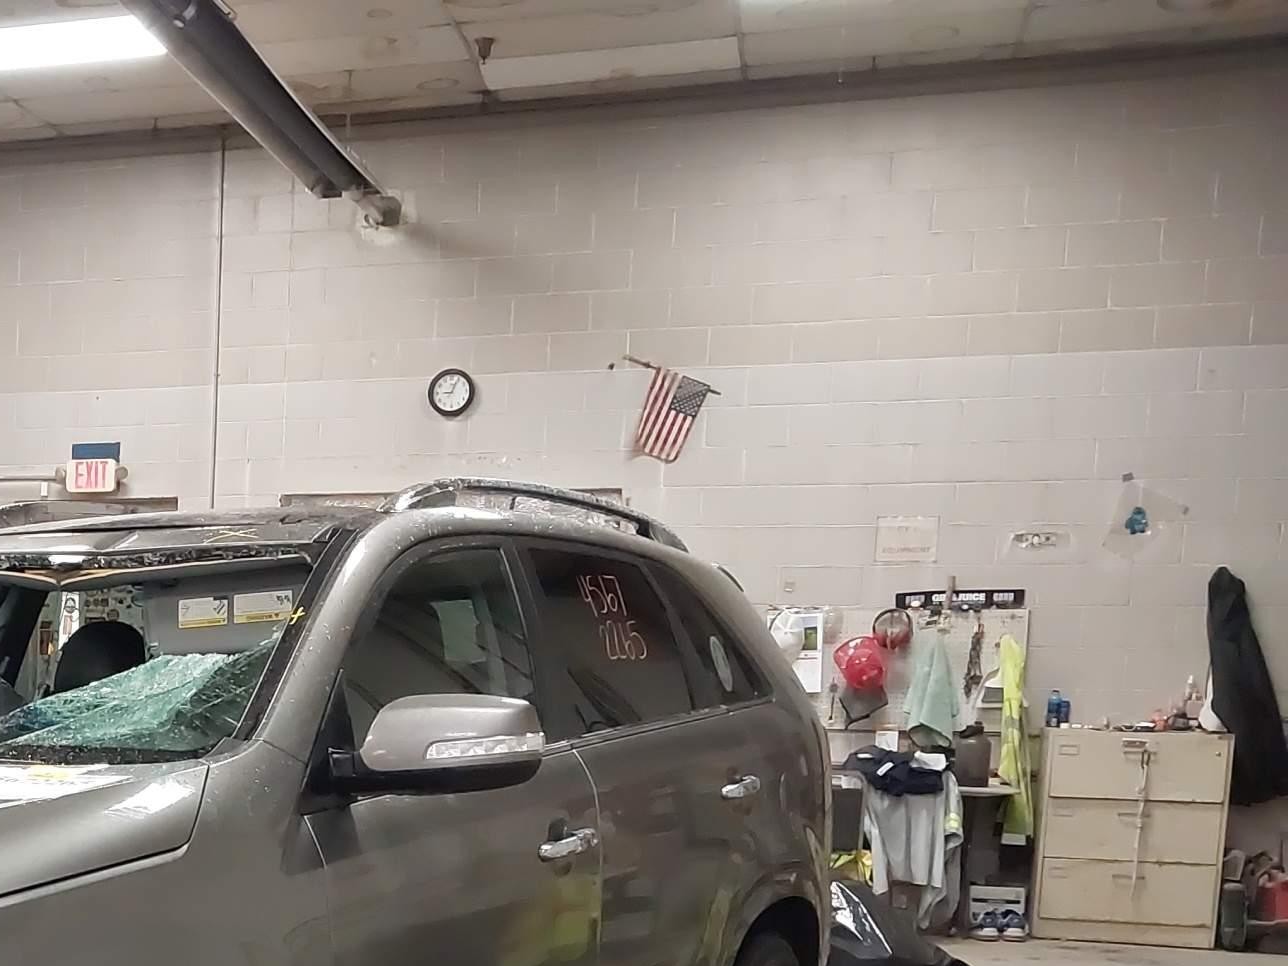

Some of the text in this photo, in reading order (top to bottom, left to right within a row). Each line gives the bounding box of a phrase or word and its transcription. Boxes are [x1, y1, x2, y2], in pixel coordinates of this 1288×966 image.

[75, 461, 108, 488] EXIT
[576, 575, 627, 616] 4567
[600, 621, 647, 660] 2265
